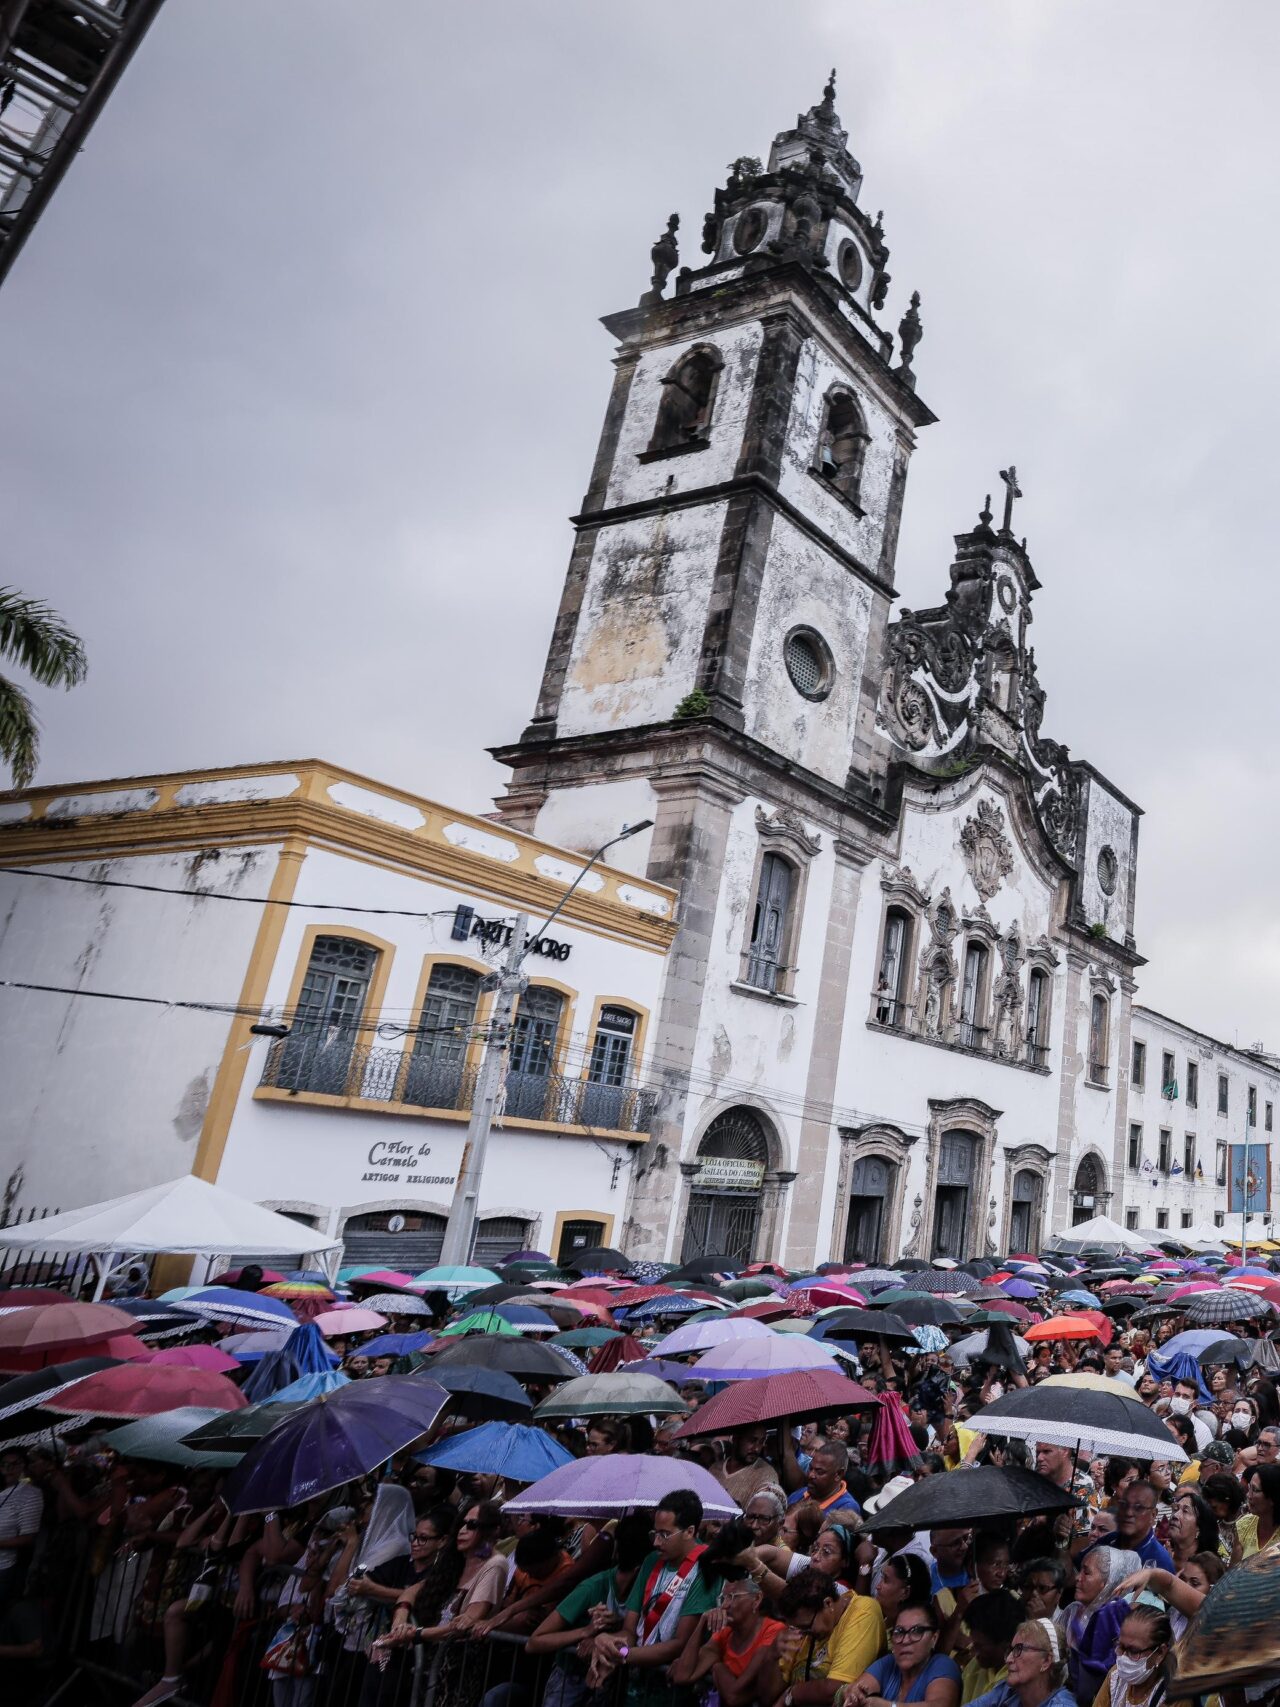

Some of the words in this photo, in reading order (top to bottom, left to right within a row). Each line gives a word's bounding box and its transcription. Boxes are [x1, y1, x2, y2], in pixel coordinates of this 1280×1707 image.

[368, 1141, 418, 1168] Carmelo
[388, 1141, 413, 1154] Flor
[418, 1143, 431, 1156] do
[705, 1158, 721, 1166] LOJA
[361, 1172, 400, 1182] ARTIGOS
[406, 1175, 455, 1185] RELIGIOSOS
